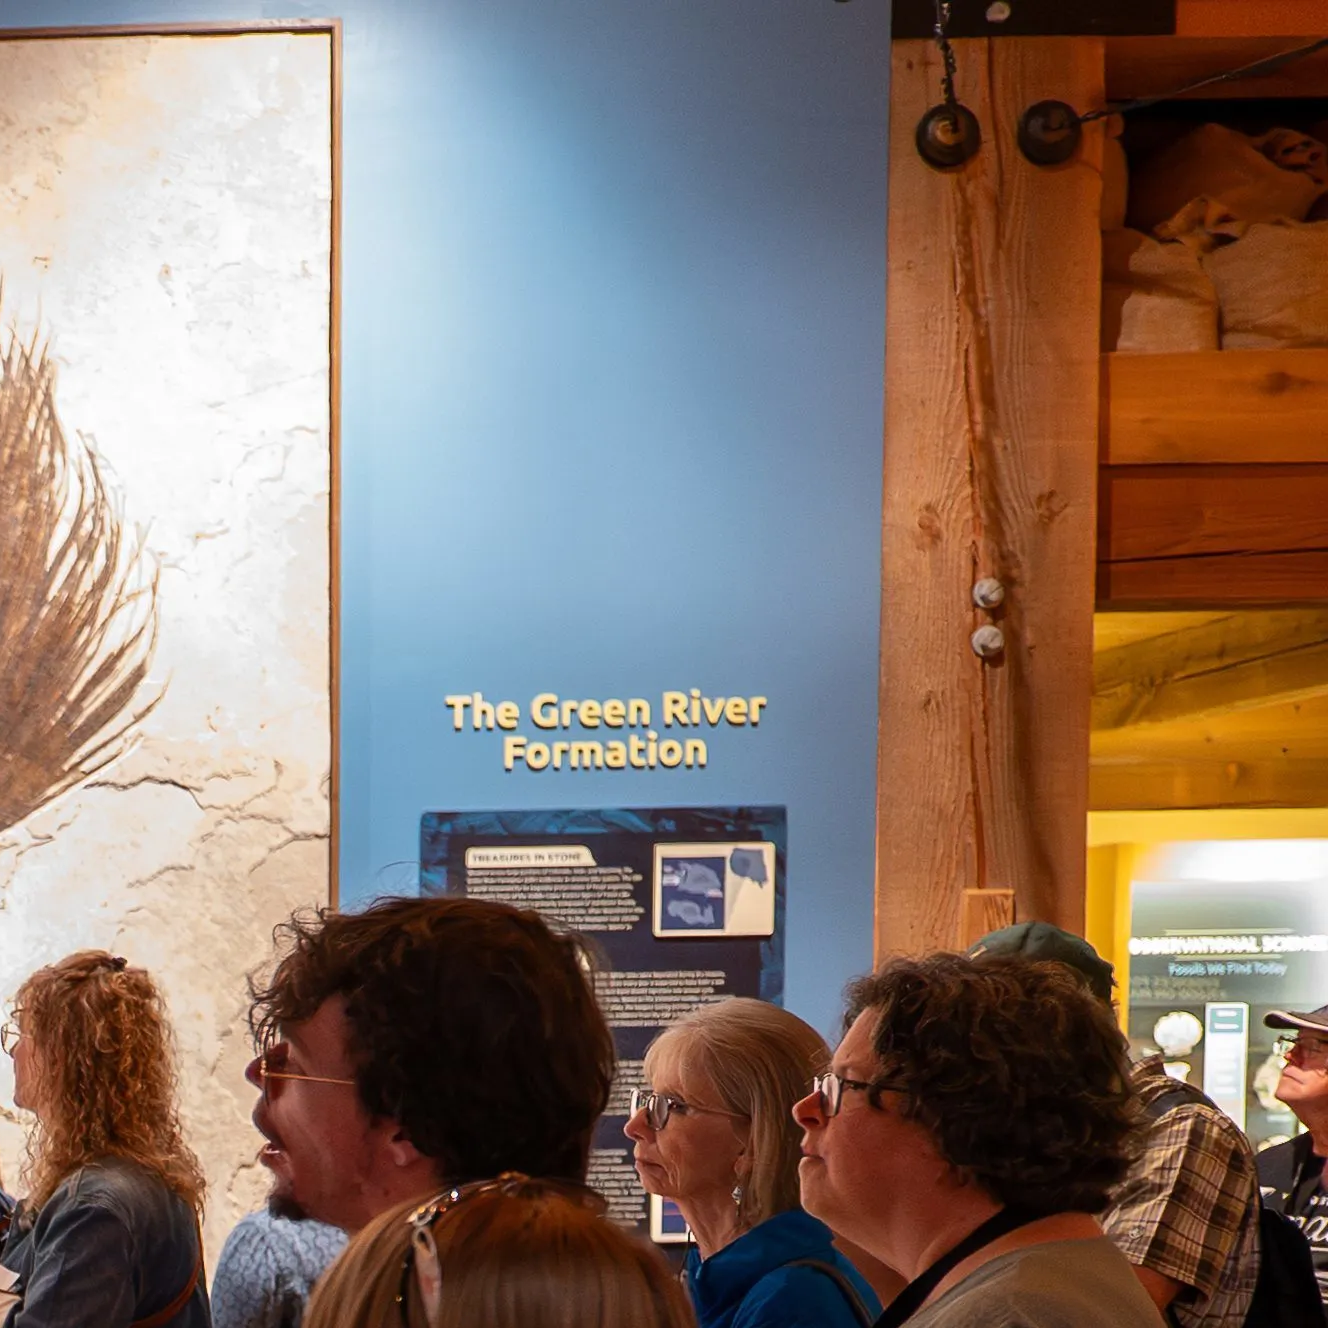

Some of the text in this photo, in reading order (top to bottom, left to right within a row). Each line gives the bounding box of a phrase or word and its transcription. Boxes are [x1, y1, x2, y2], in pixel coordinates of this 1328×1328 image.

[445, 689, 768, 730] The Green River
[504, 731, 707, 770] Formation
[473, 852, 580, 862] TREASURES IN STONE
[1168, 961, 1288, 976] Fossils We Find Today
